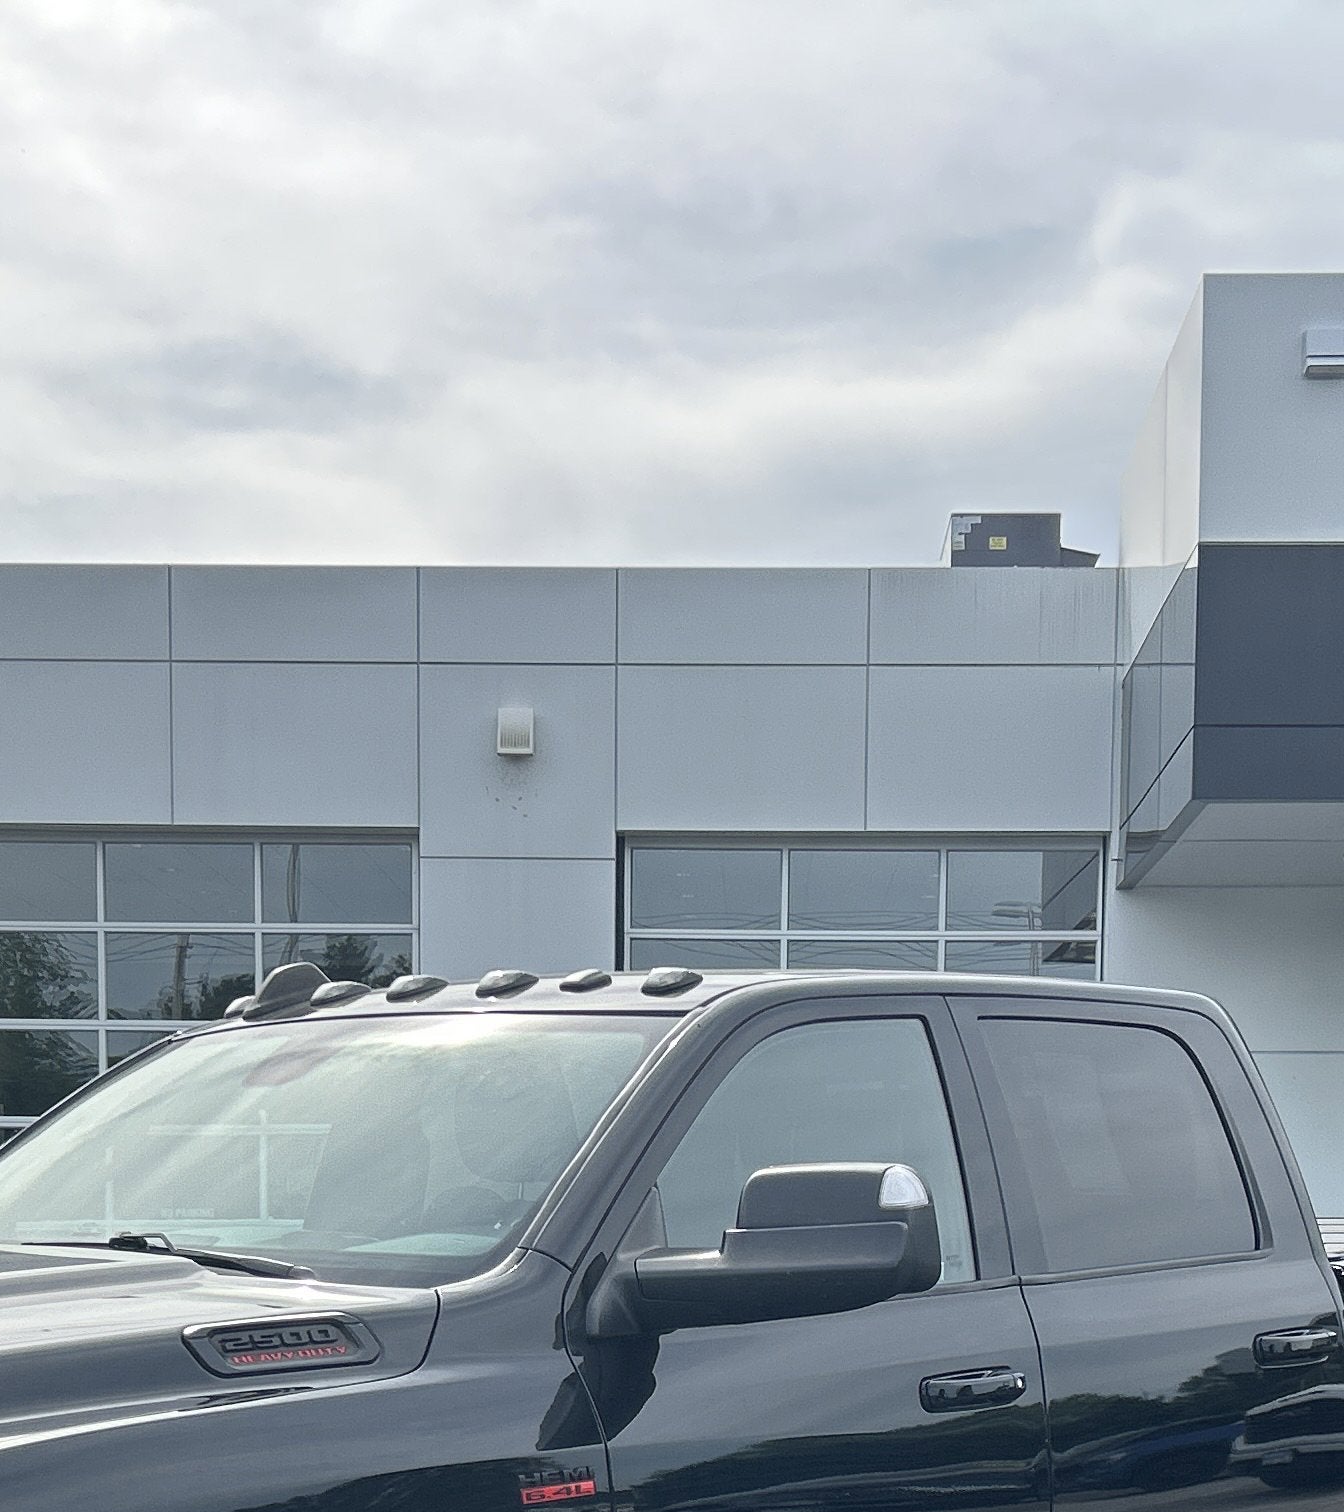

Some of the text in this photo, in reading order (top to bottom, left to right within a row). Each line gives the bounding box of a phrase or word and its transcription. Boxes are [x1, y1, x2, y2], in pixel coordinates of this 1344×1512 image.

[218, 1328, 339, 1353] 2500
[231, 1345, 348, 1365] HEAVY DUTY
[518, 1465, 595, 1488] HEMI
[525, 1483, 594, 1501] 6.4L
